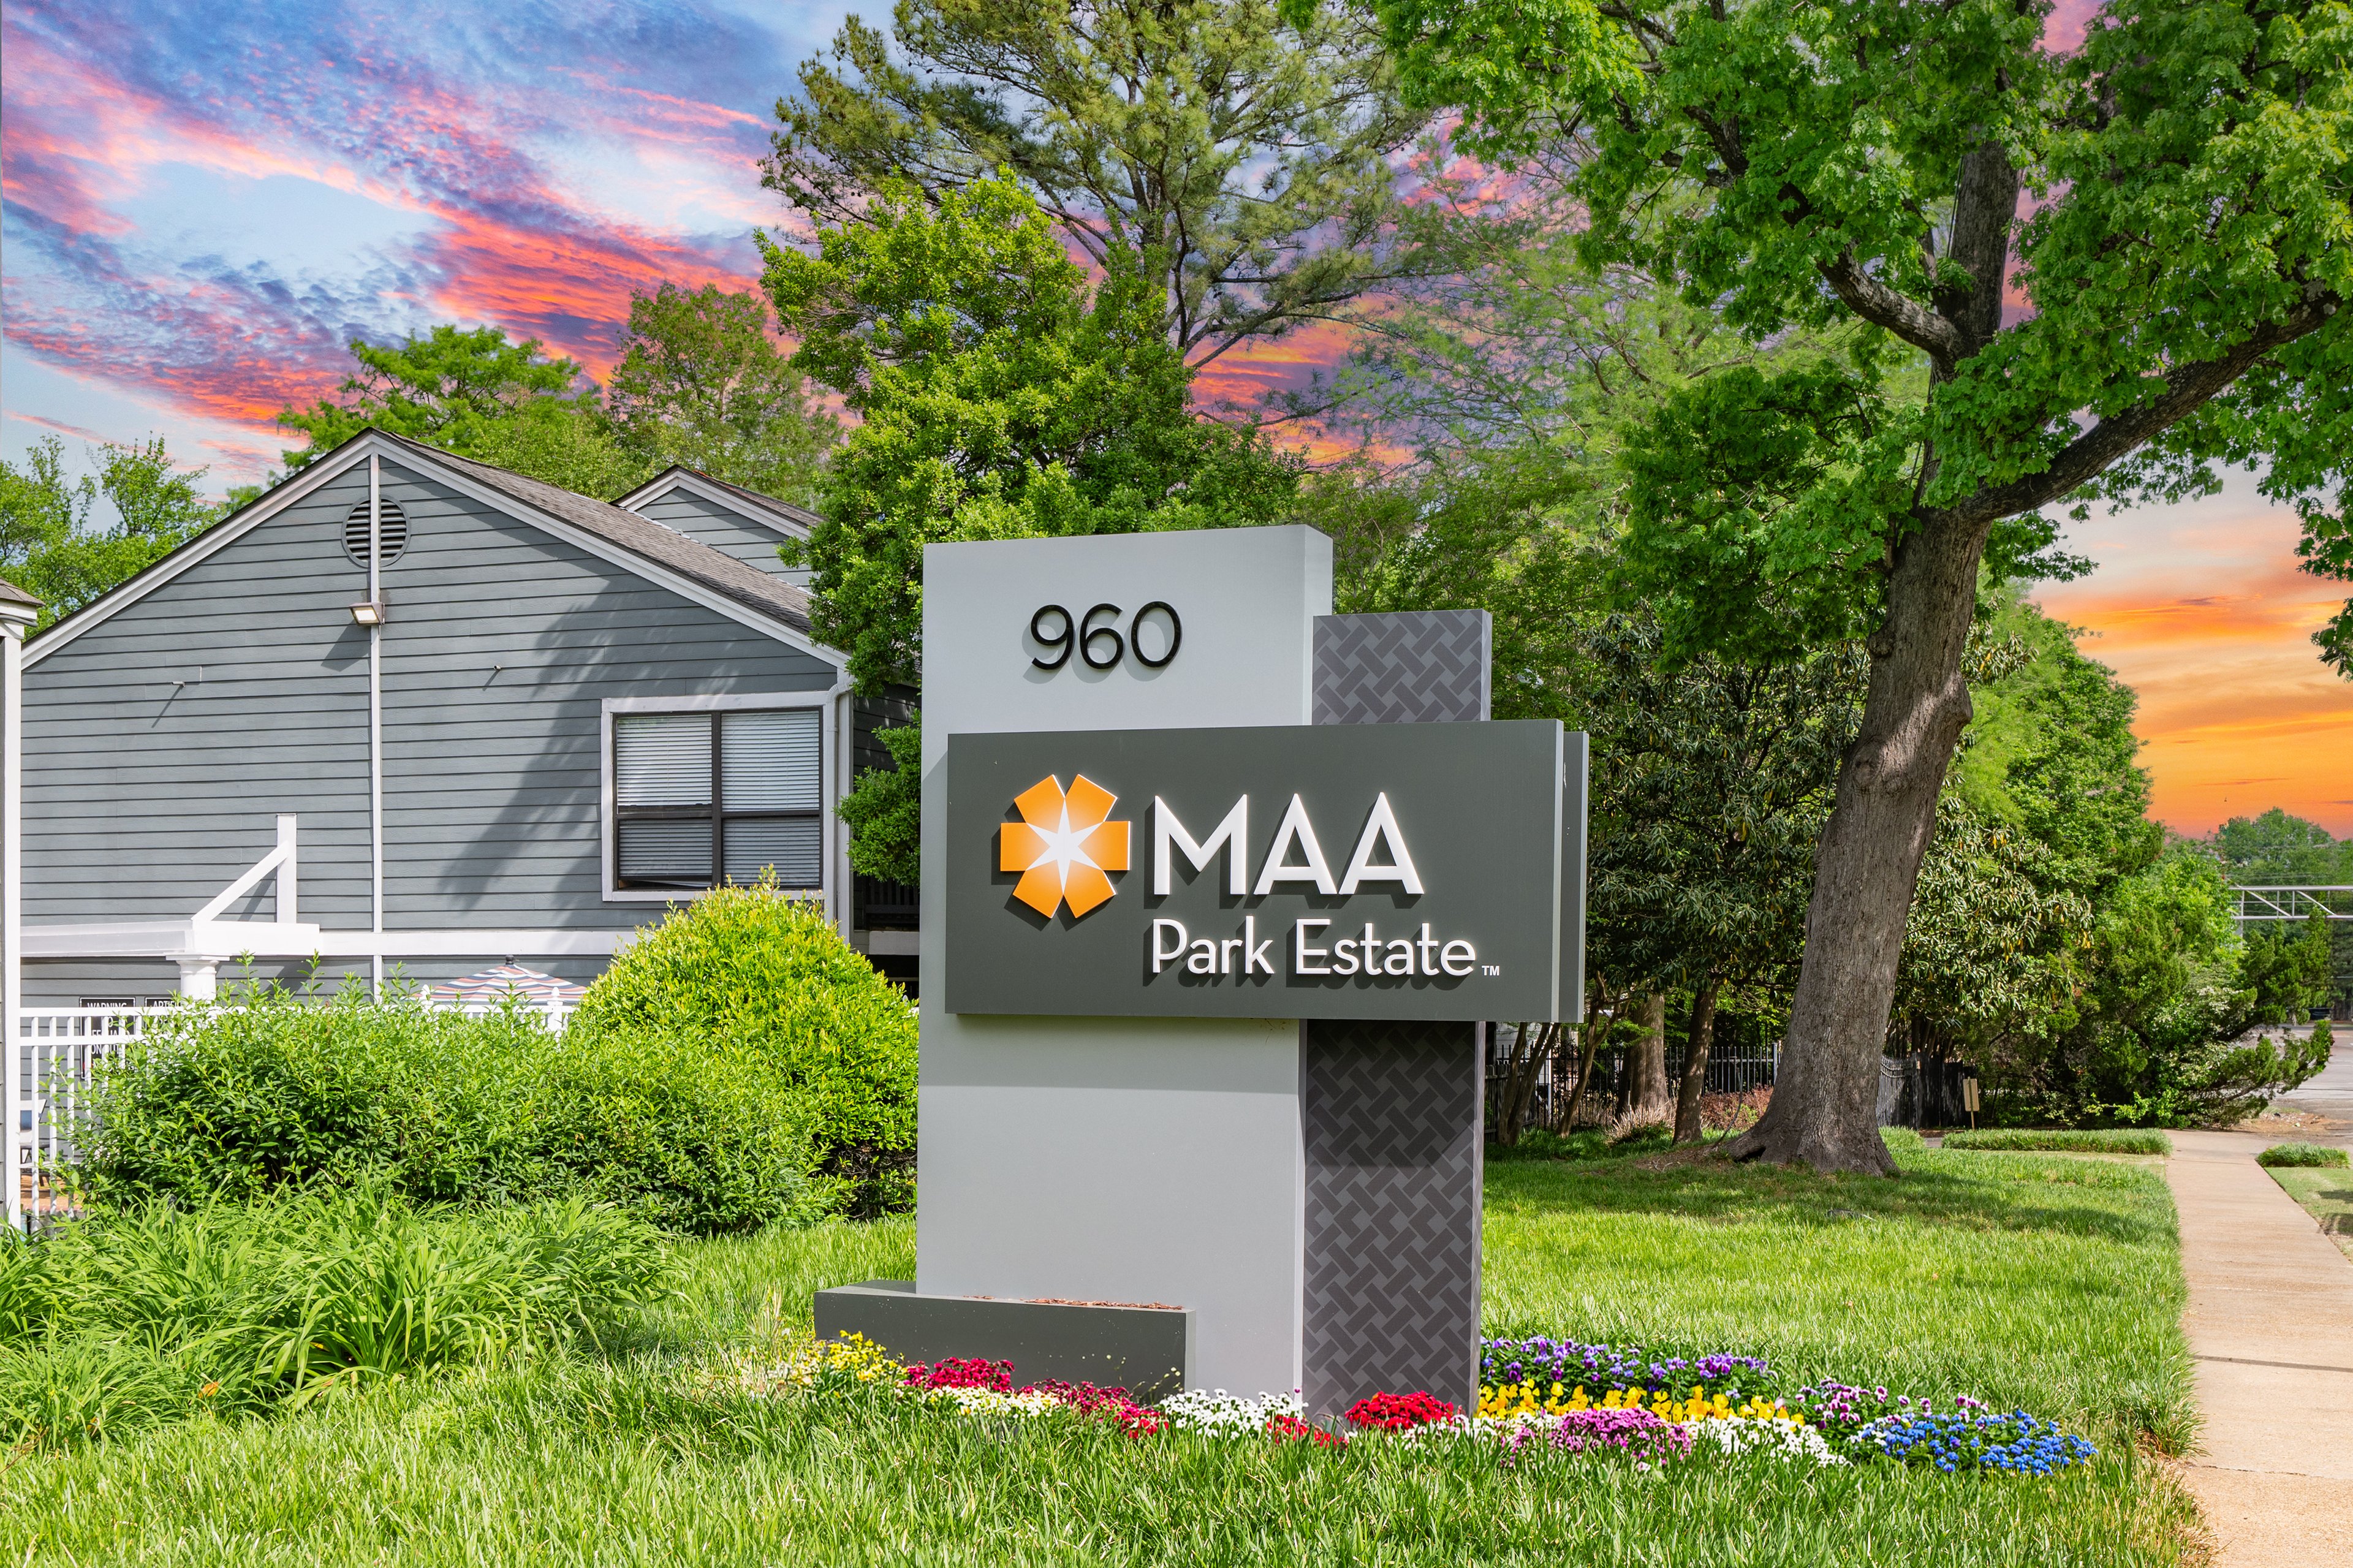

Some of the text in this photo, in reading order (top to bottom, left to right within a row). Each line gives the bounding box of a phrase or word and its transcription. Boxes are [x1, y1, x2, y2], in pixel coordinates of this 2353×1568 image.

[1030, 600, 1183, 670] 960
[1154, 792, 1425, 895] MAA
[1152, 915, 1275, 975] Park
[1295, 918, 1477, 977] Estate
